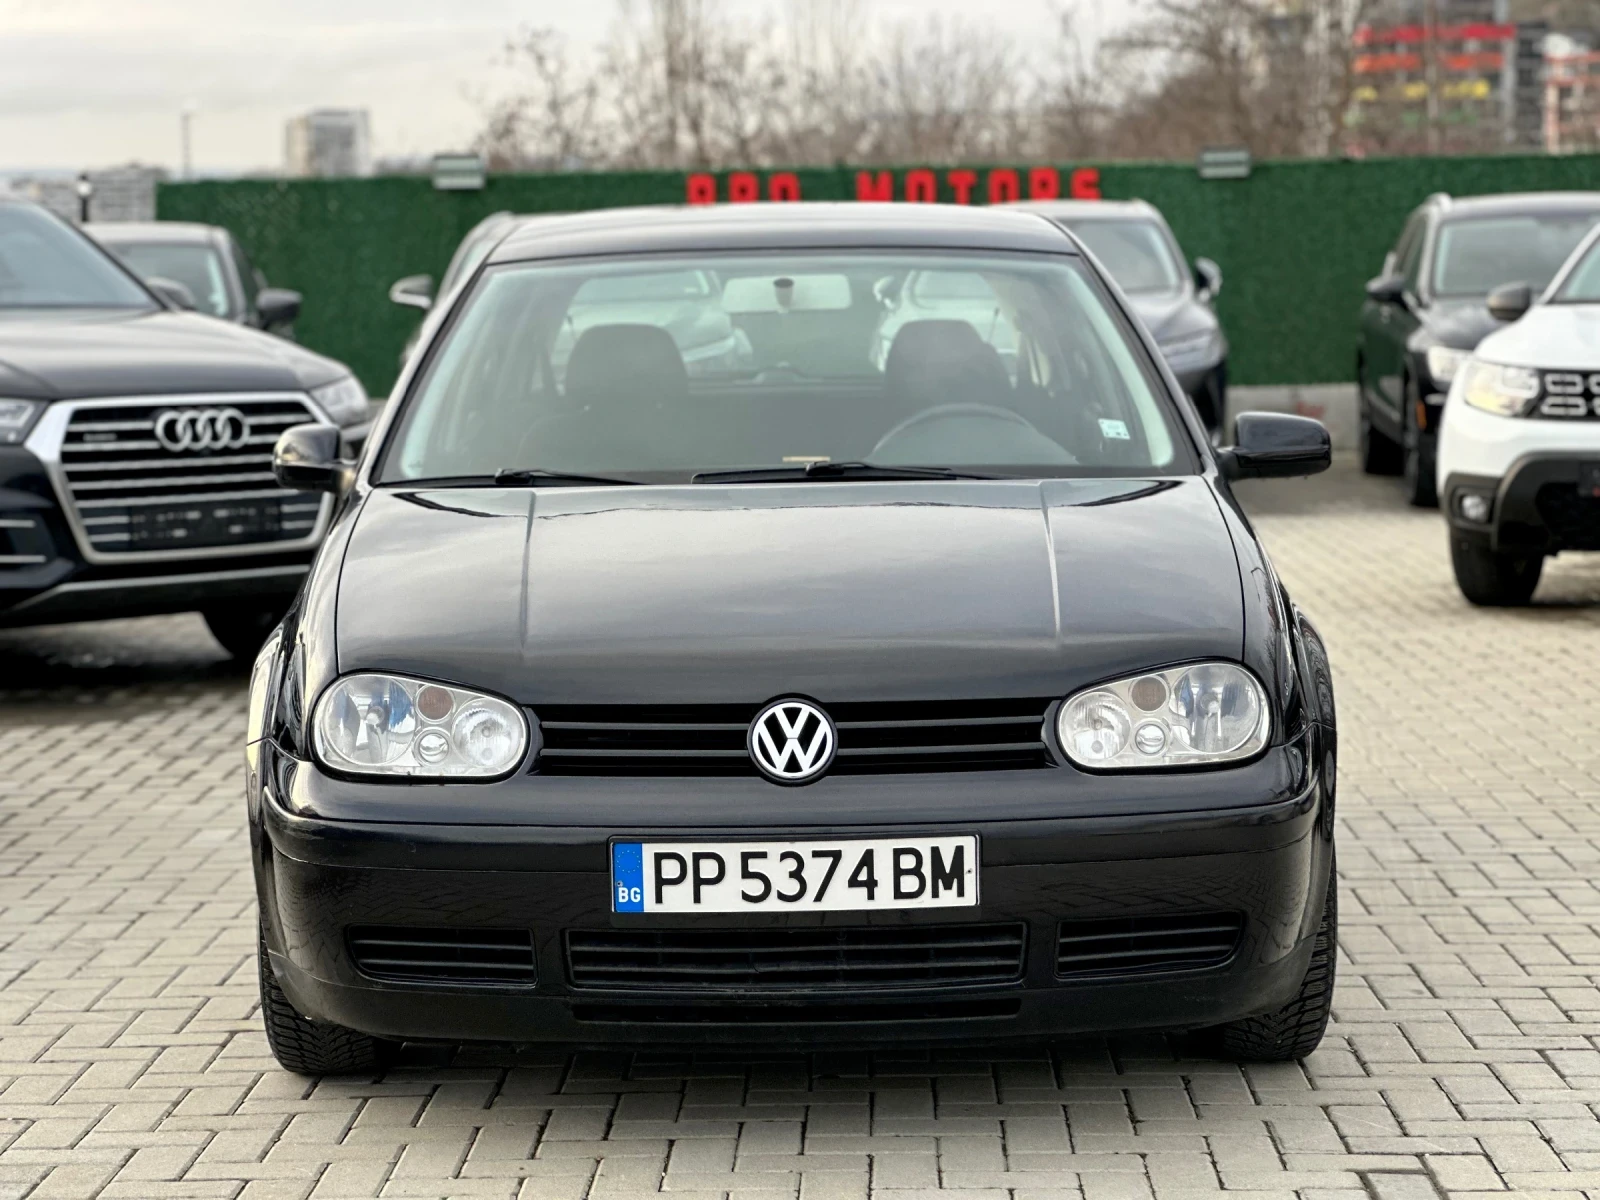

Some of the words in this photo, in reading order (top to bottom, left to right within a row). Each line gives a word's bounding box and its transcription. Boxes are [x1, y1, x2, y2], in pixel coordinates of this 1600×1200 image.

[752, 702, 833, 778] VW
[618, 887, 641, 903] BG
[653, 851, 726, 904] PP
[740, 848, 879, 903] 5374
[892, 845, 965, 900] BM
